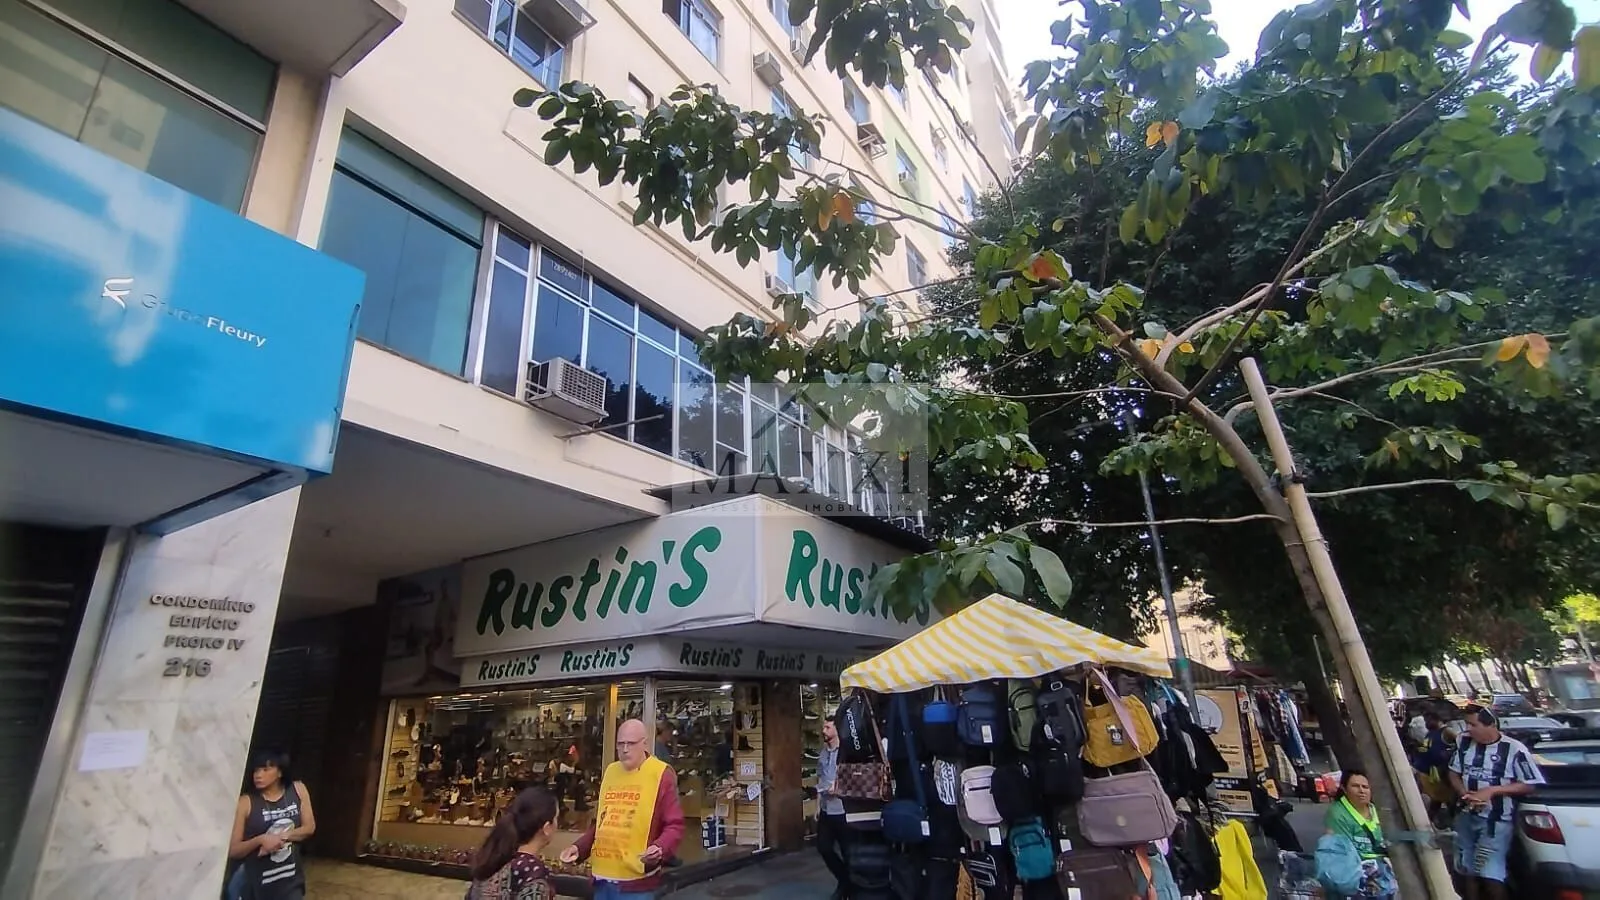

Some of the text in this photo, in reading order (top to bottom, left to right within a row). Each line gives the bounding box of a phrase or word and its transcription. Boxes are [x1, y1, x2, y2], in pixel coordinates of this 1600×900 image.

[476, 526, 722, 636] Rustin'S
[150, 594, 256, 613] CONDOMÍNIO
[169, 614, 240, 631] EDIFÍCIO
[163, 634, 246, 651] PROKO IV
[478, 643, 634, 681] Rustin'S Rustin'S
[680, 642, 743, 668] Rustin'S
[162, 656, 213, 678] 216
[605, 792, 641, 801] COMPRO
